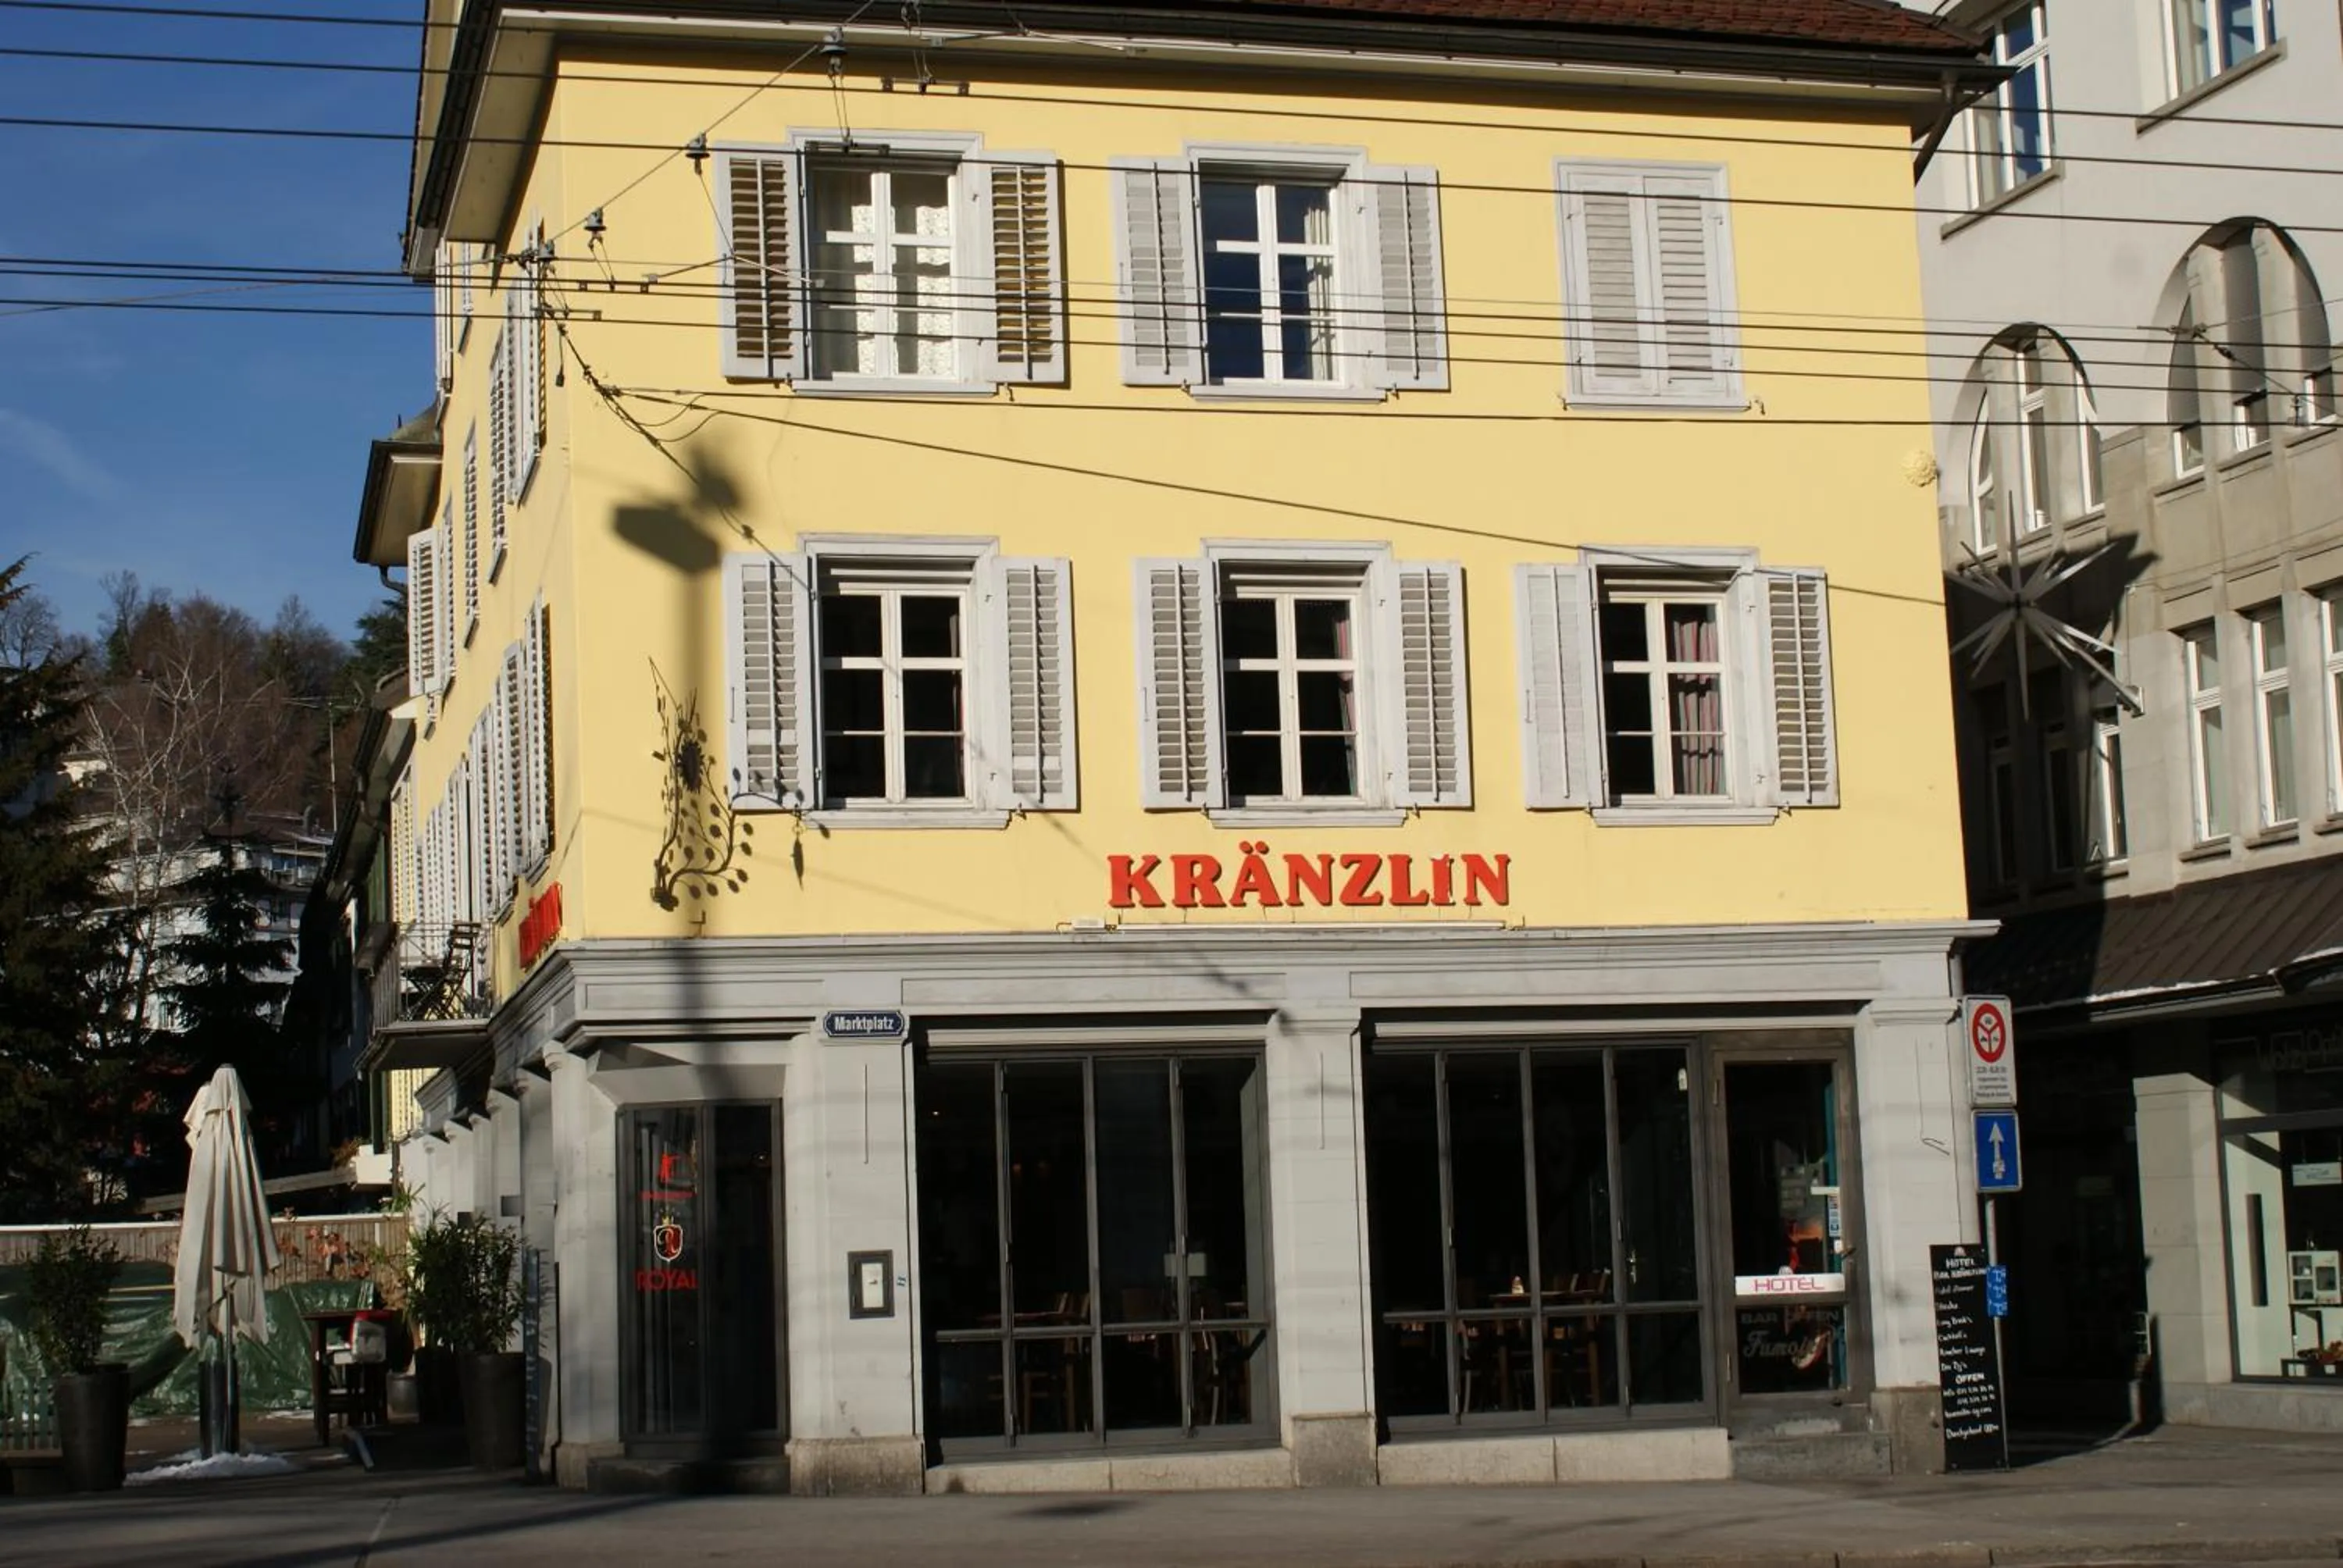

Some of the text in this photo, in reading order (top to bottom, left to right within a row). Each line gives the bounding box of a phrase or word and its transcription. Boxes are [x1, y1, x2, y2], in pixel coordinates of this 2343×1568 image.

[1107, 841, 1510, 907] KRÄNZLIN
[835, 1016, 894, 1033] Marktplatz
[636, 1270, 697, 1290] ROYAL
[1754, 1277, 1824, 1292] HOTEL
[1741, 1313, 1778, 1324] BAR
